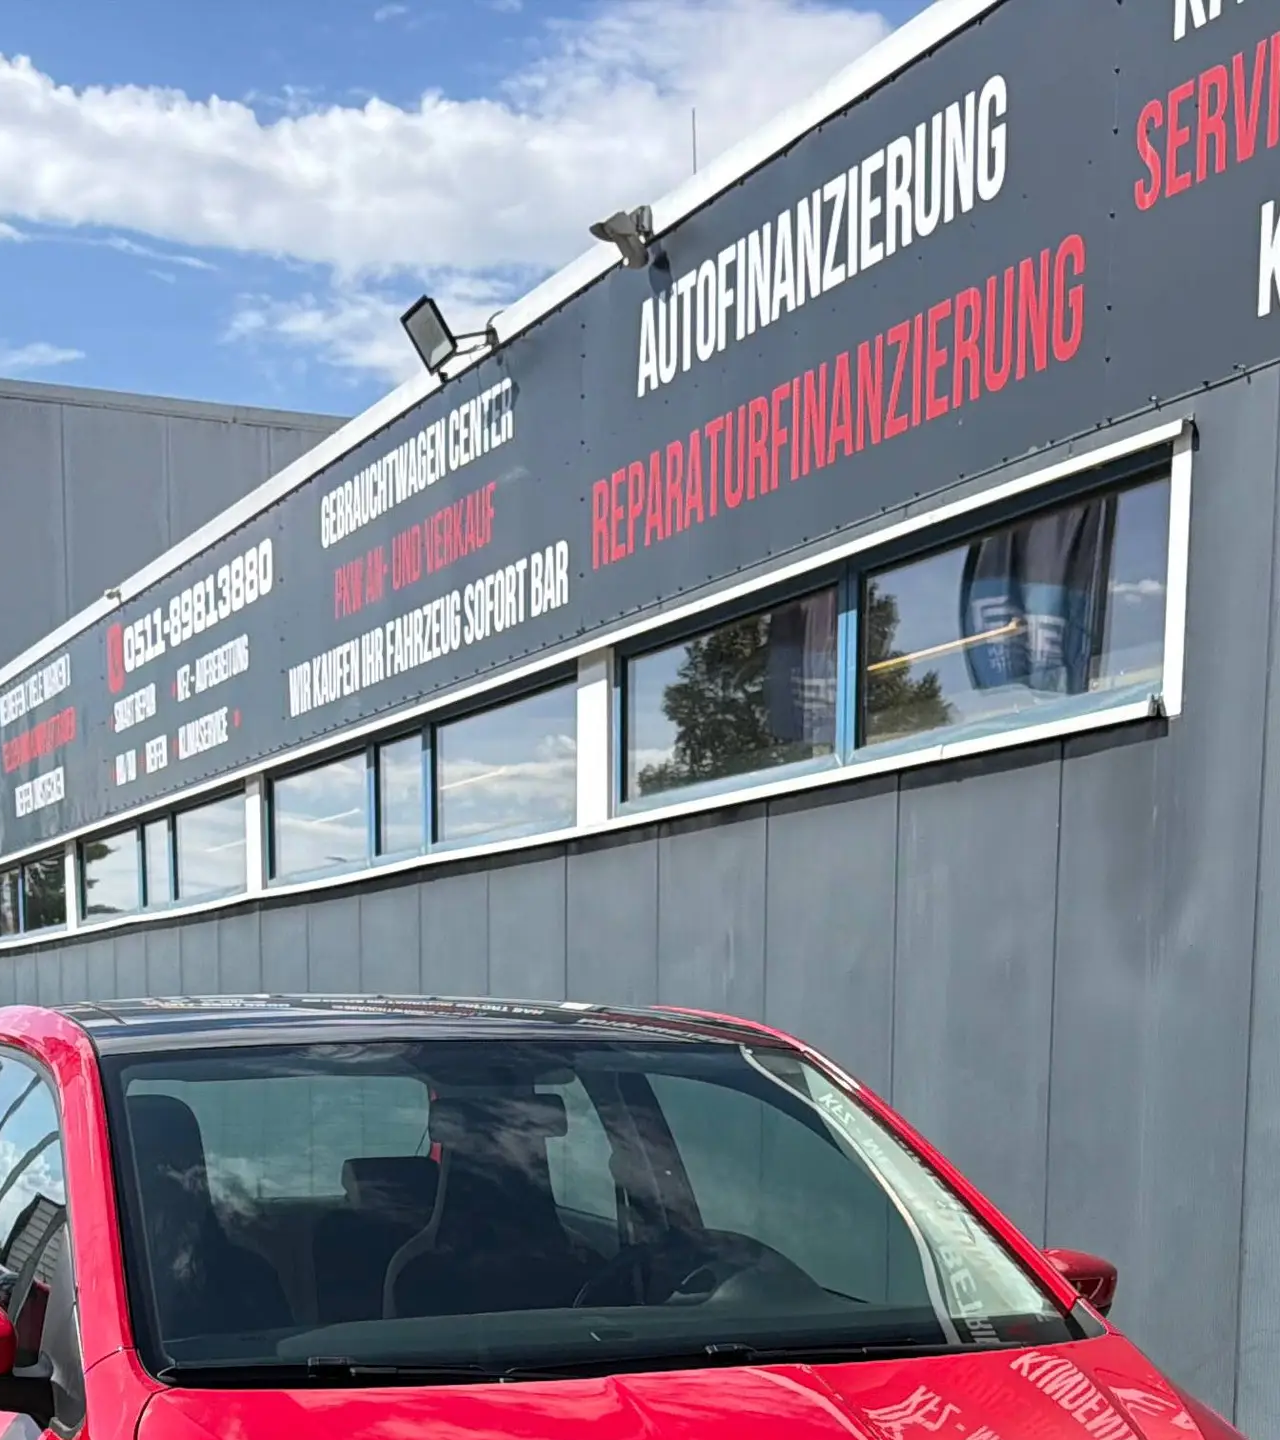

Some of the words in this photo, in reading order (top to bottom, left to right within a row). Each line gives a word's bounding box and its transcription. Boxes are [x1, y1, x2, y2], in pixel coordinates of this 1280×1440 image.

[636, 74, 1008, 398] AUTOFINANZIERUNG
[320, 416, 447, 549] GEBRAUCHTWAGEN
[448, 376, 515, 472] CENTER
[592, 234, 1086, 571] REPARATURFINANZIERUNG
[123, 537, 273, 674] 0511-89813880
[391, 522, 421, 591] UND
[424, 479, 497, 577] VERKAUF
[288, 659, 312, 718] WIR
[311, 635, 361, 709] KAUFEN
[360, 626, 385, 689] IHR
[385, 589, 462, 678] FAHRZEUG
[463, 558, 528, 645] SOFORT
[529, 540, 569, 618] BAR
